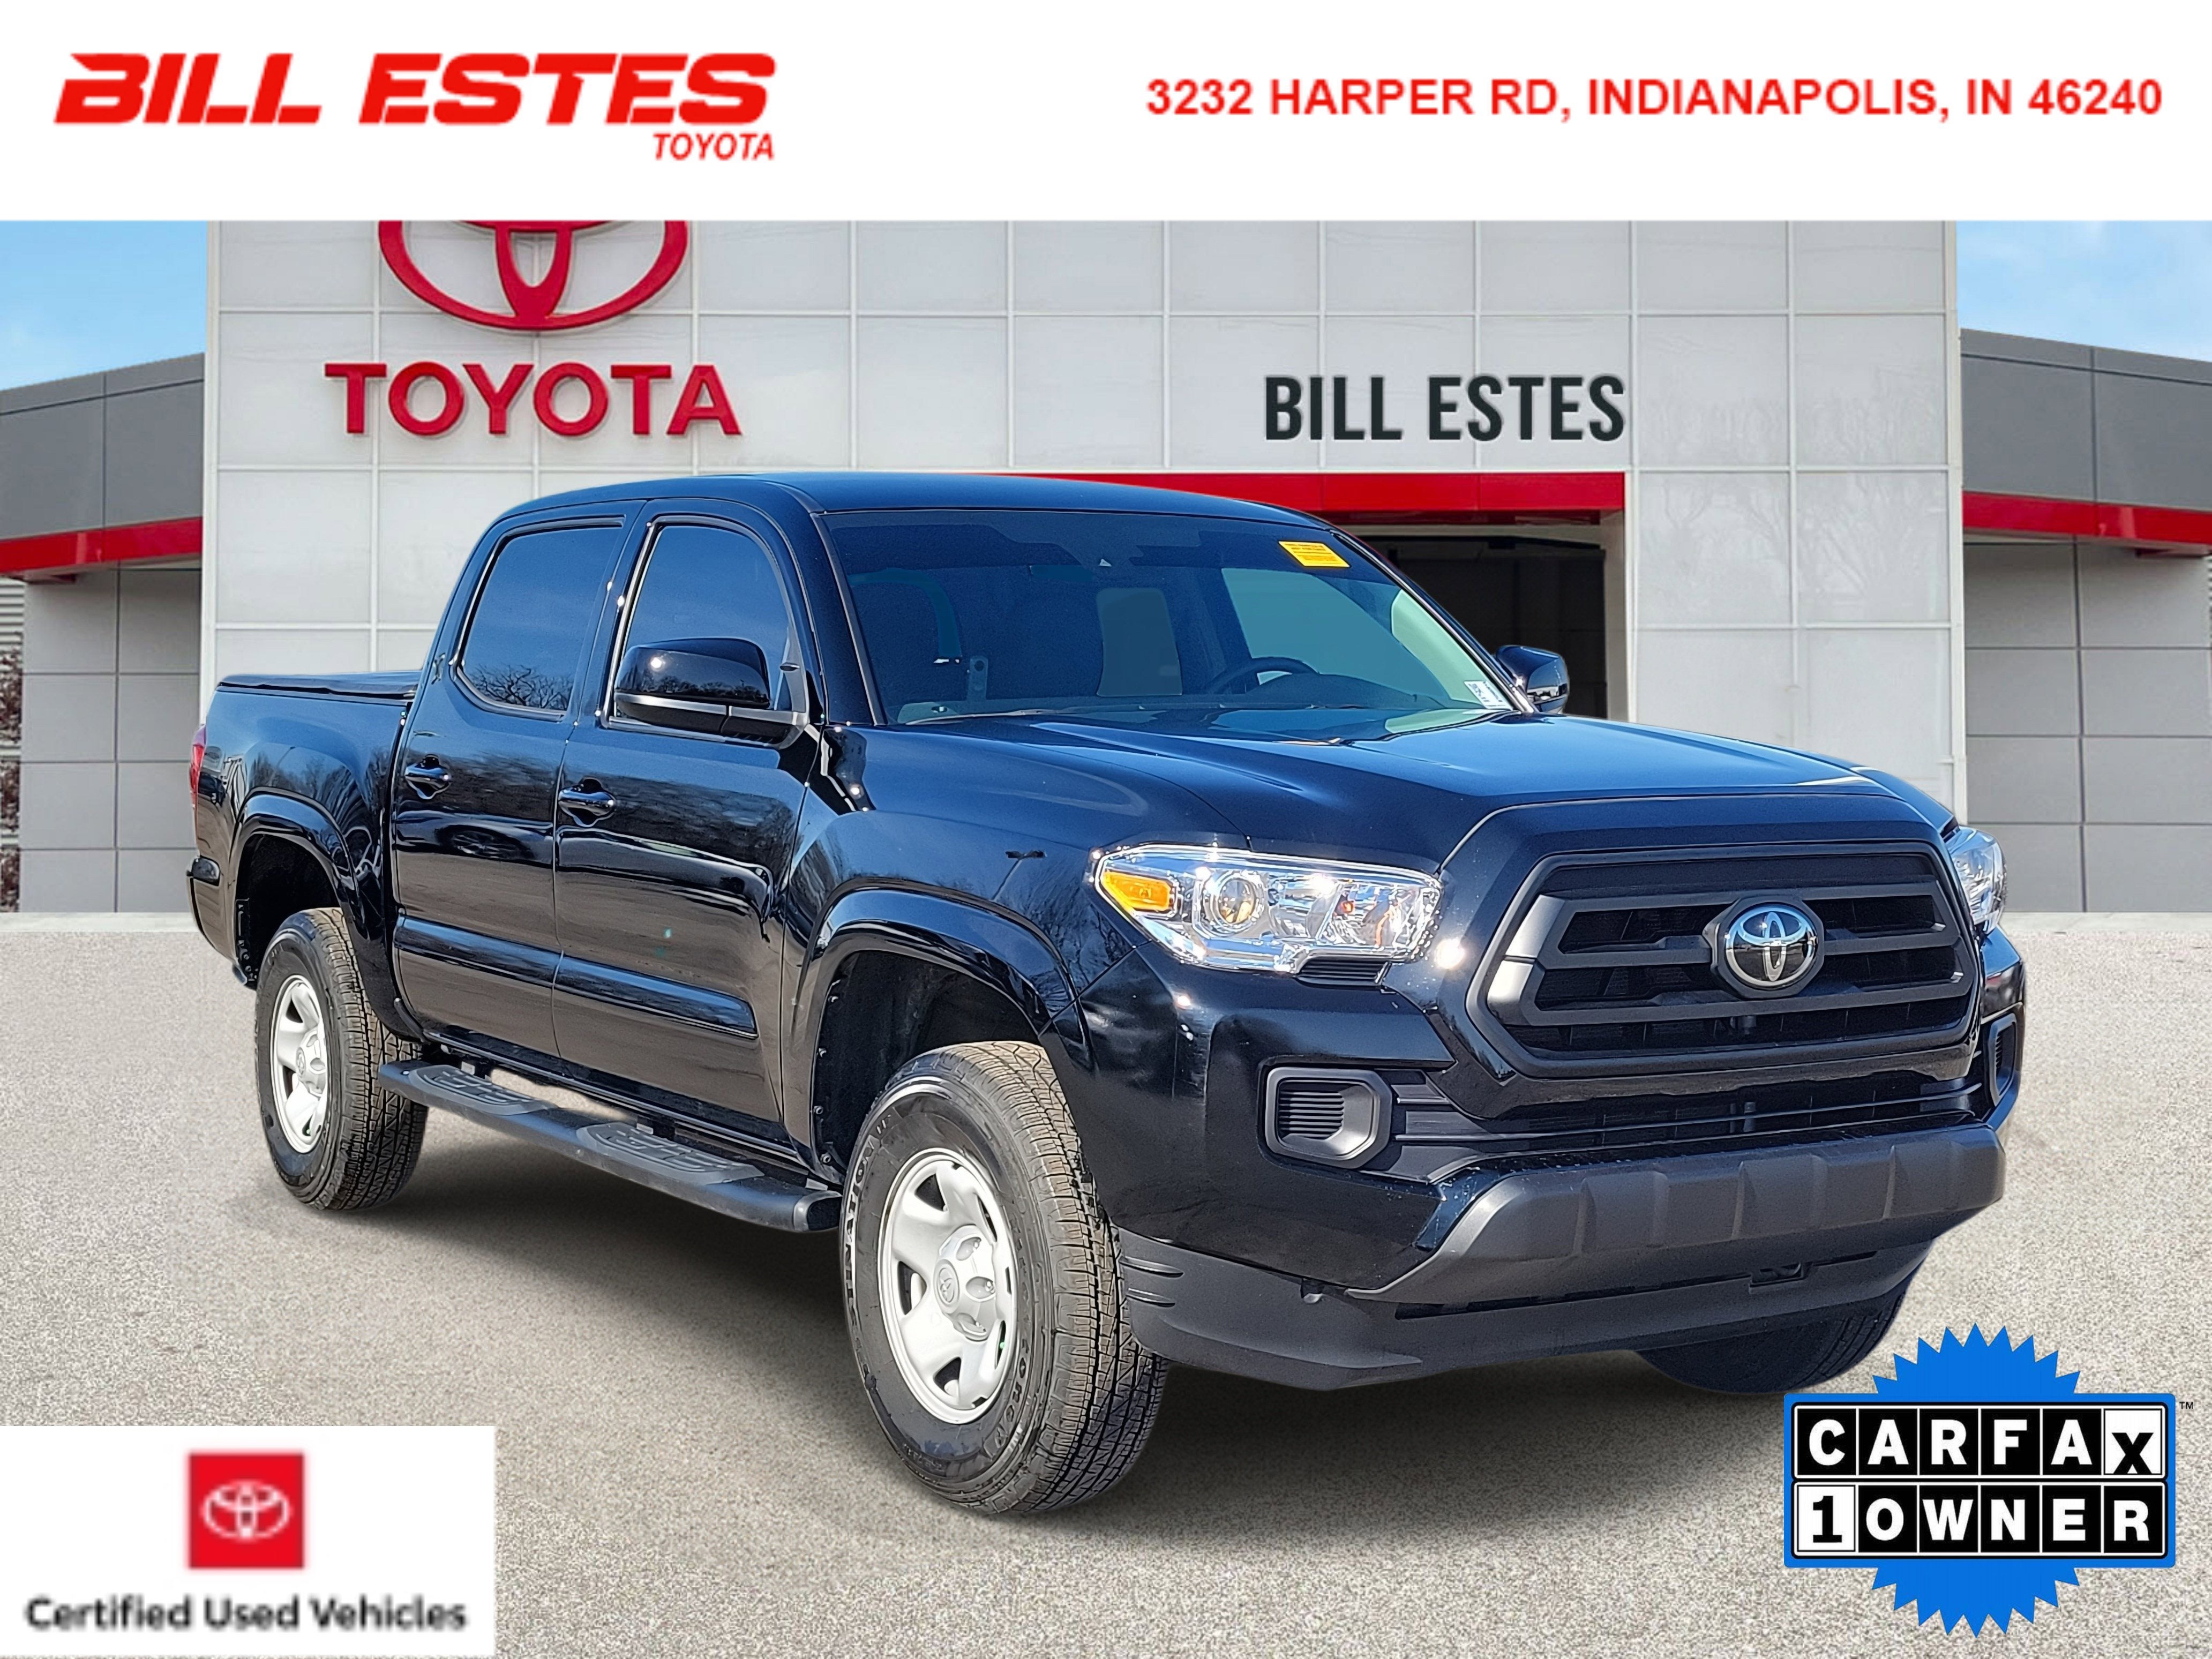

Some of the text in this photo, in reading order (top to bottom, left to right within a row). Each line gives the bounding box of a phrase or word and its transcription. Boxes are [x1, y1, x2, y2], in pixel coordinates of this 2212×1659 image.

[325, 361, 741, 436] TOYOTA
[1265, 373, 1625, 441] BILL ESTES
